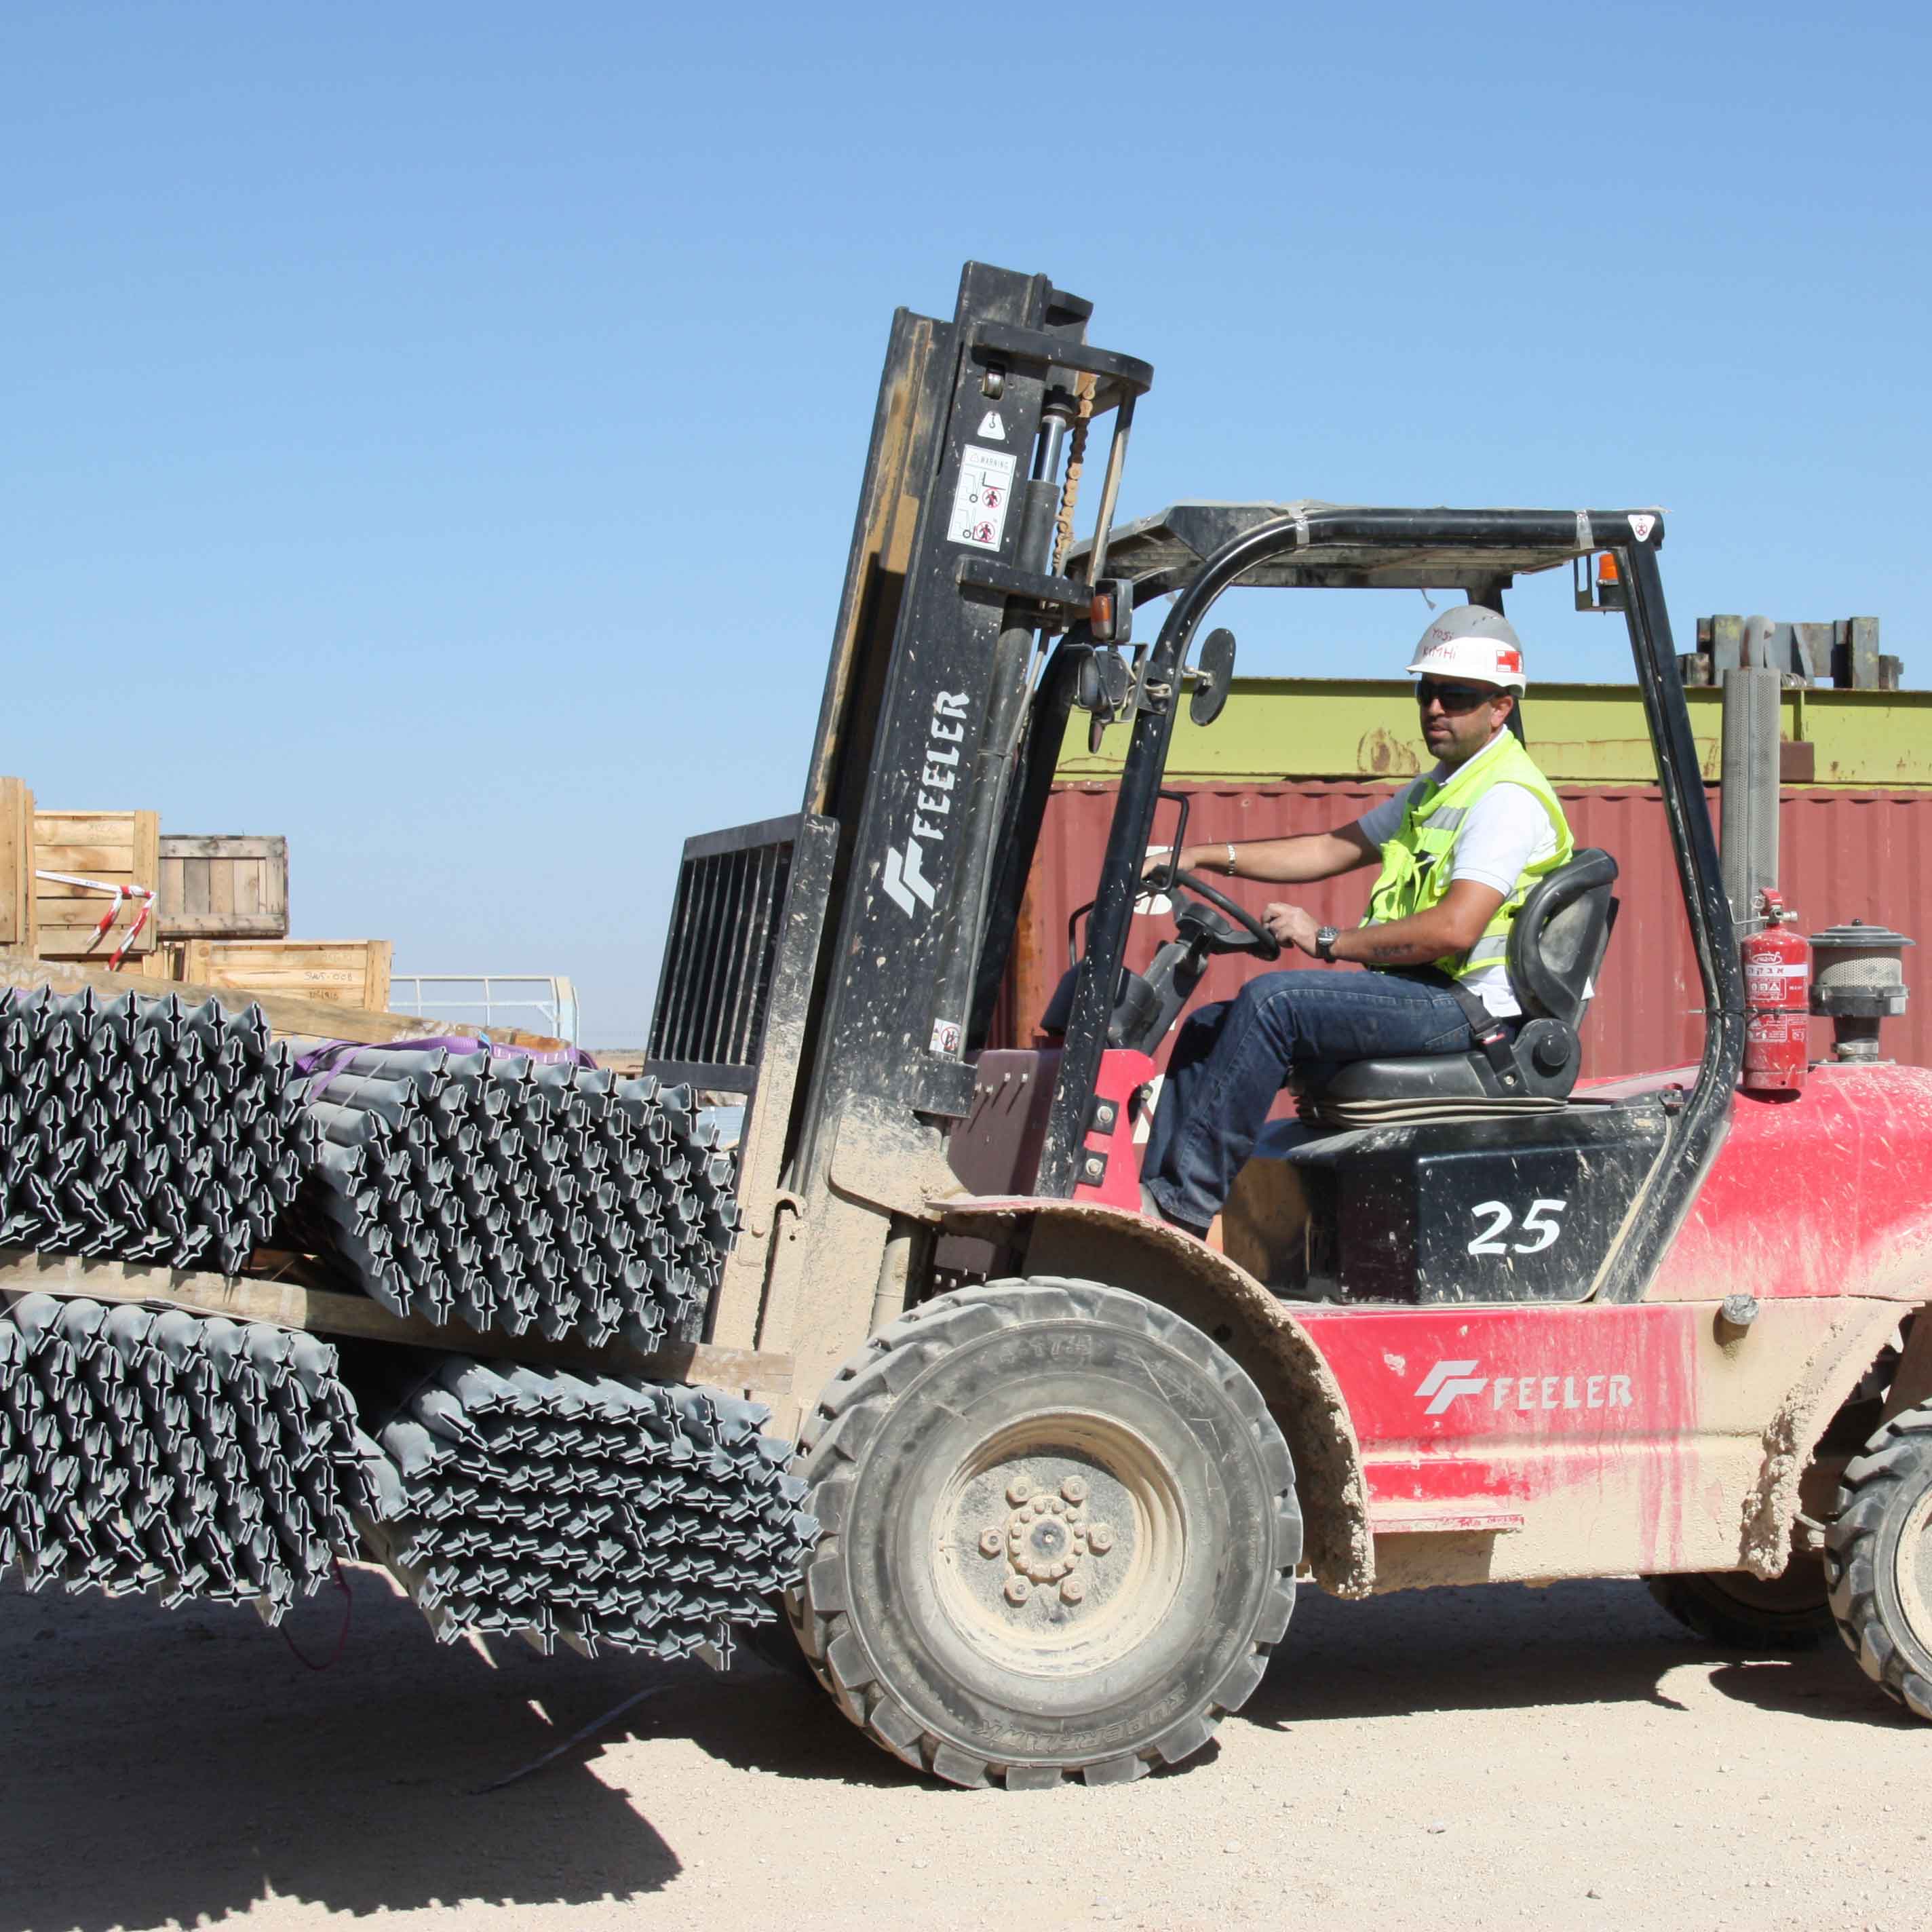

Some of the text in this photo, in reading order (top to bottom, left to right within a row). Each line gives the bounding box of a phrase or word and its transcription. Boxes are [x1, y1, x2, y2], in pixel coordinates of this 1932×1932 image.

[980, 455, 1010, 470] WARNING
[912, 691, 971, 841] FEELER
[1467, 1199, 1567, 1255] 25
[1493, 1374, 1634, 1411] FEELER
